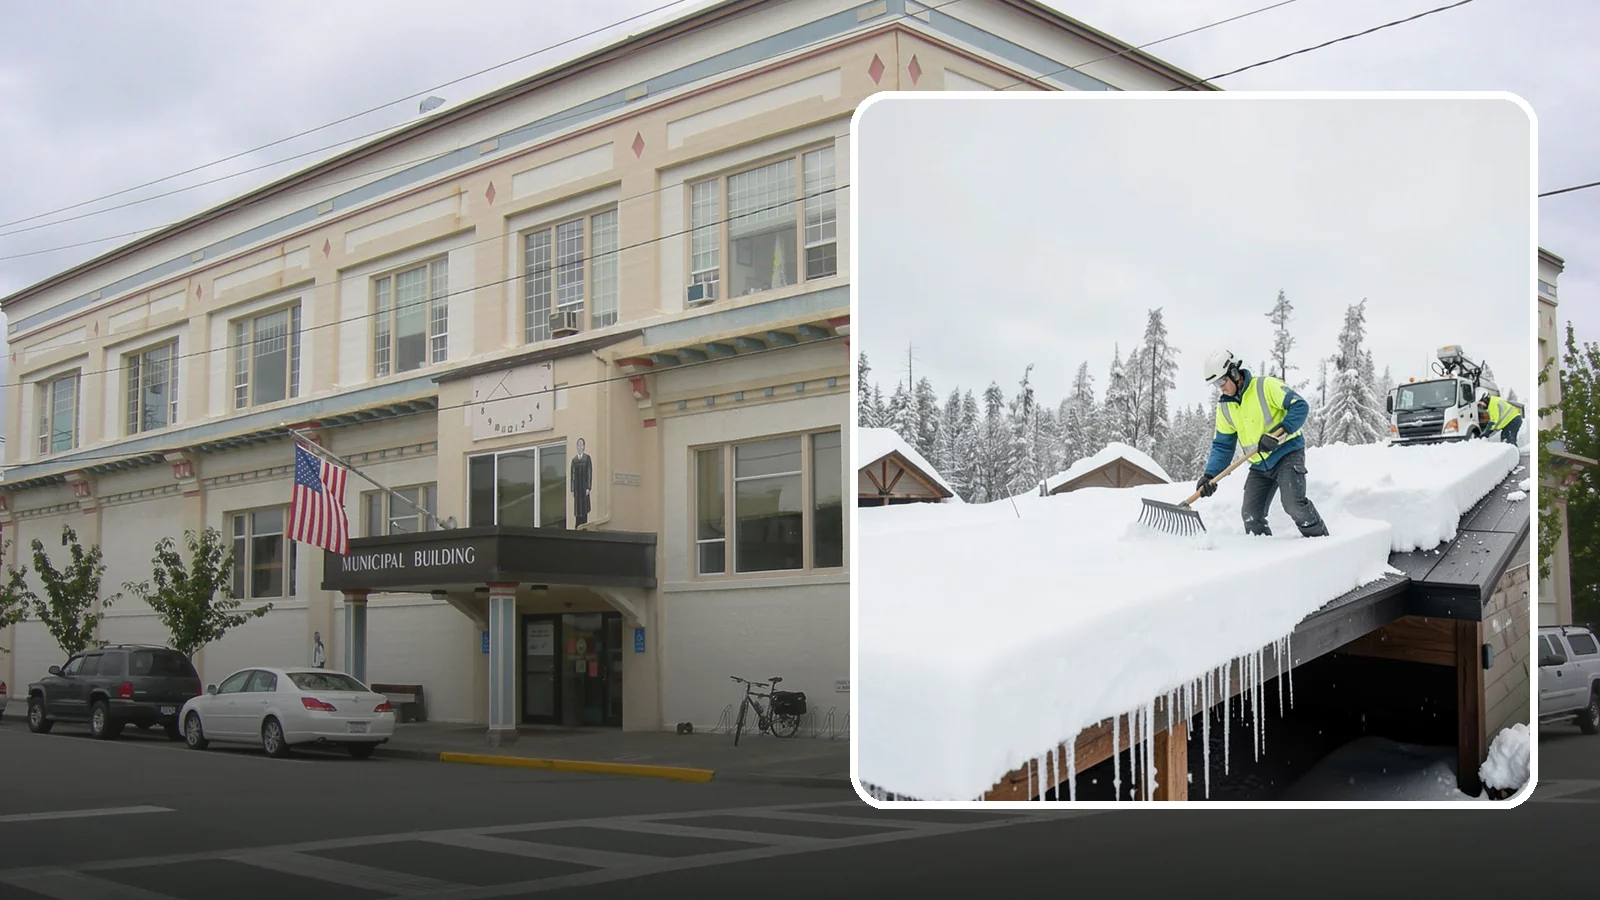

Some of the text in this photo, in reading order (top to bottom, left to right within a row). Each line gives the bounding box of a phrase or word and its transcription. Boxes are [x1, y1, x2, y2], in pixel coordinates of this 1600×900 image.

[480, 407, 485, 415] 8
[488, 418, 493, 426] 9
[495, 424, 500, 432] 10
[501, 425, 506, 433] 11
[508, 425, 513, 433] 12
[521, 420, 525, 428] 2
[529, 414, 533, 422] 3
[536, 402, 540, 410] 4
[342, 546, 475, 572] MUNICIPAL BUILDING
